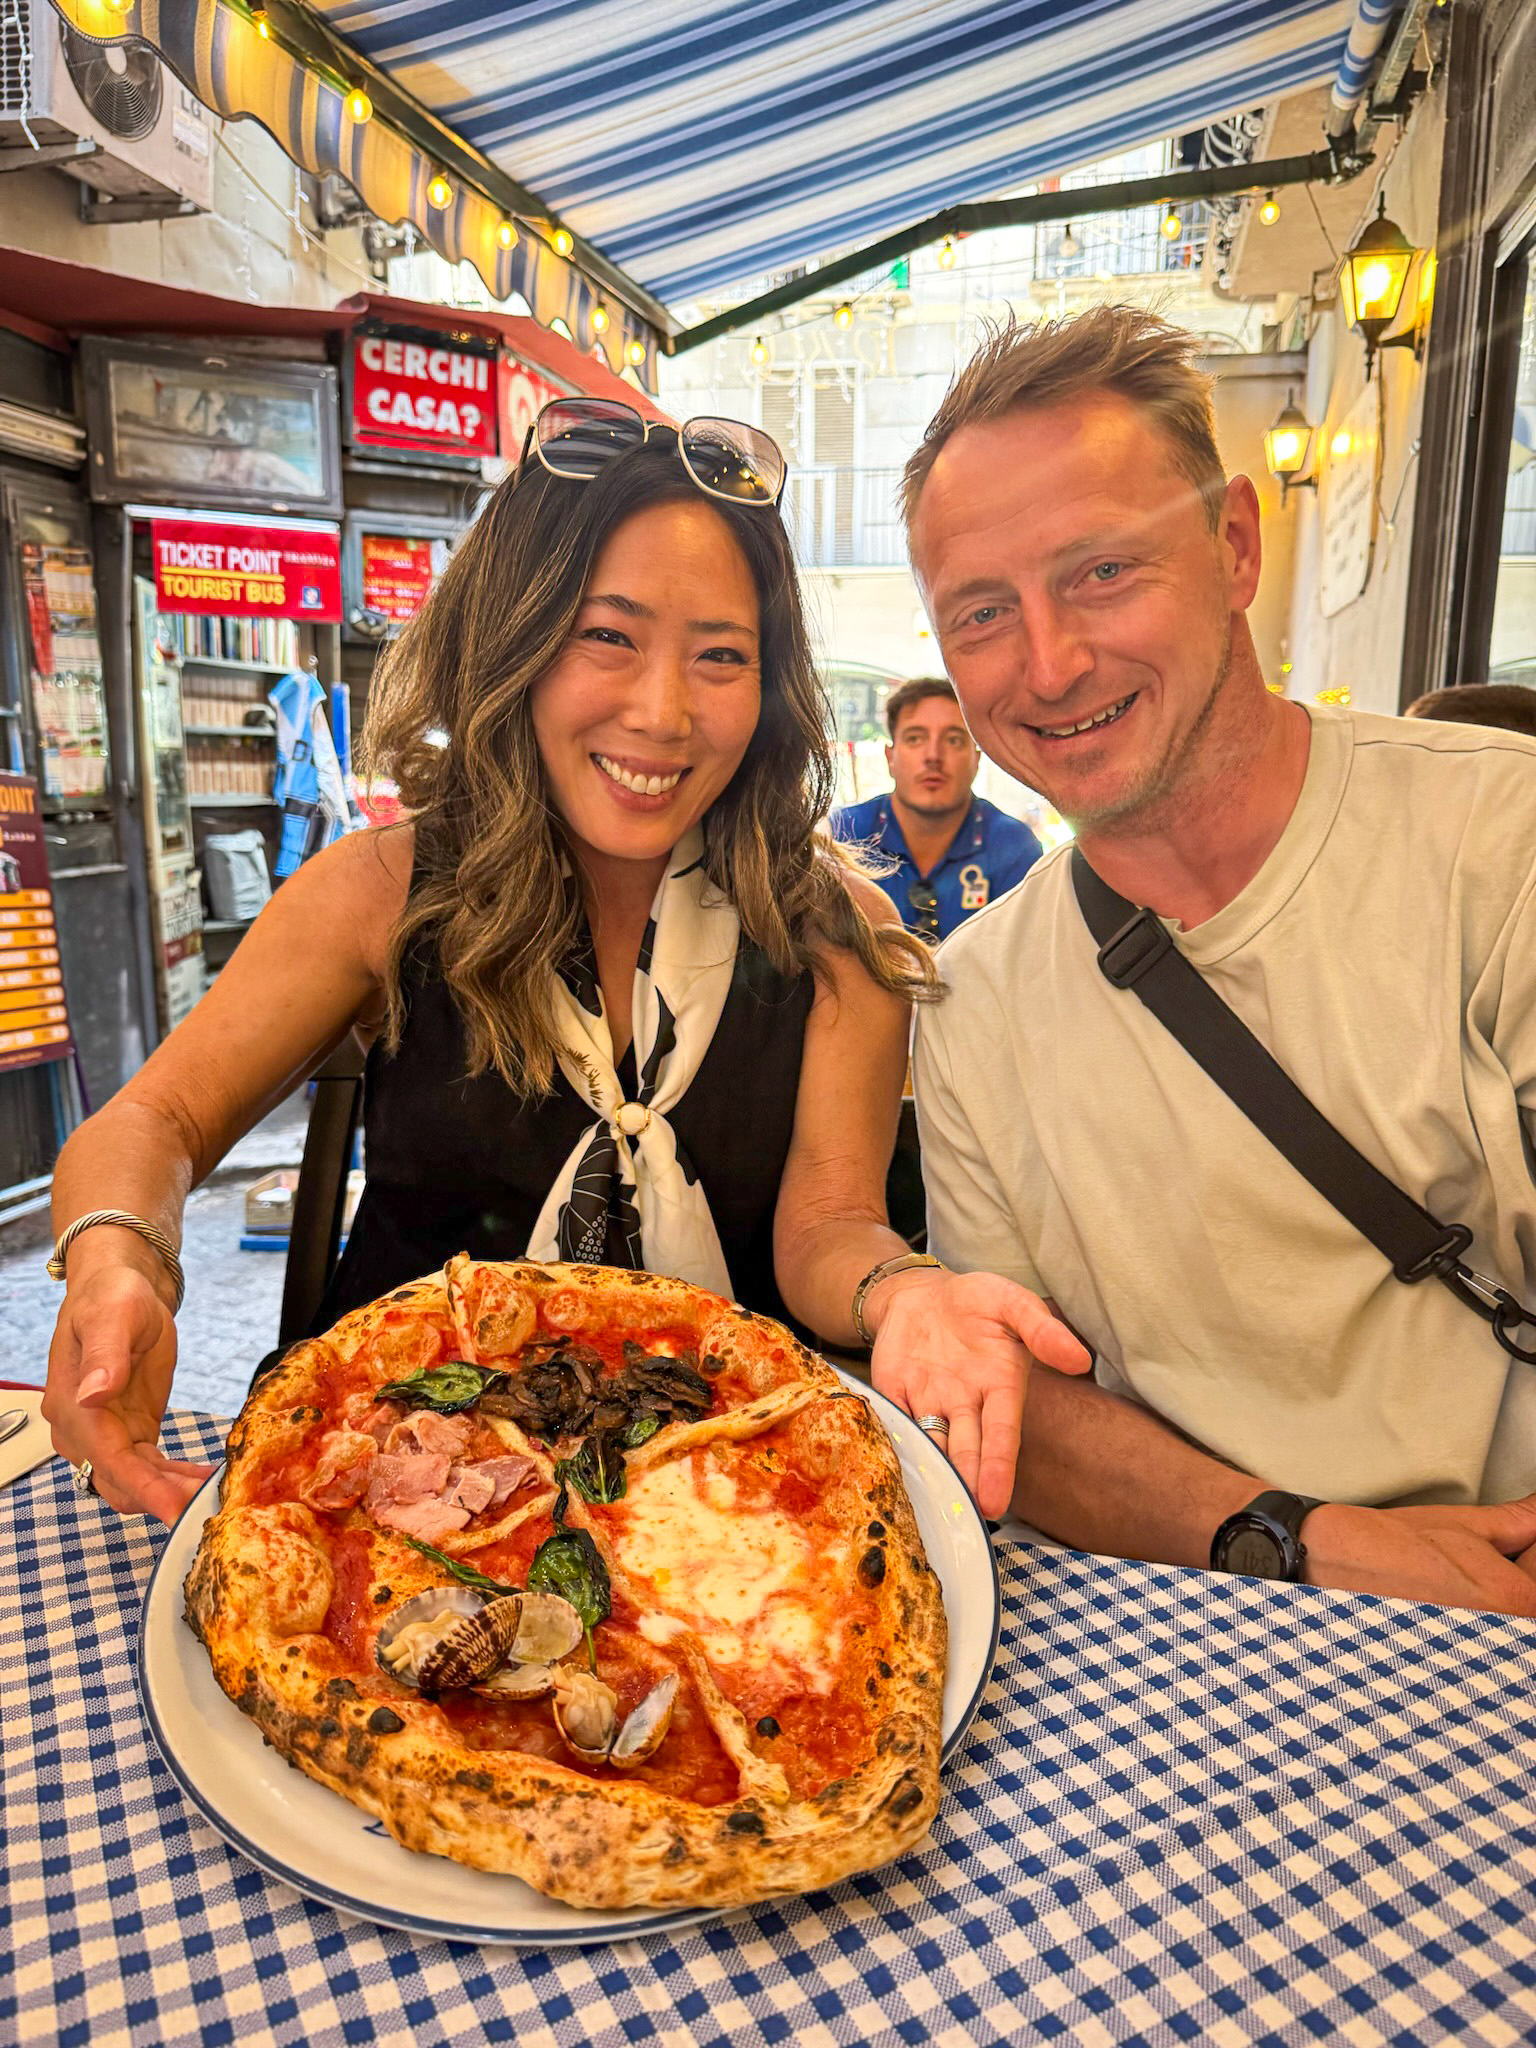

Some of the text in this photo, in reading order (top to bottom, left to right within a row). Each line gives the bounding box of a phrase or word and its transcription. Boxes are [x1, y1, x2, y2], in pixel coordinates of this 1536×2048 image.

[360, 338, 488, 392] CERCHI
[368, 386, 482, 438] CASA?
[158, 540, 225, 571] TICKET
[227, 547, 283, 575] POINT
[161, 574, 286, 606] TOURIST BUS
